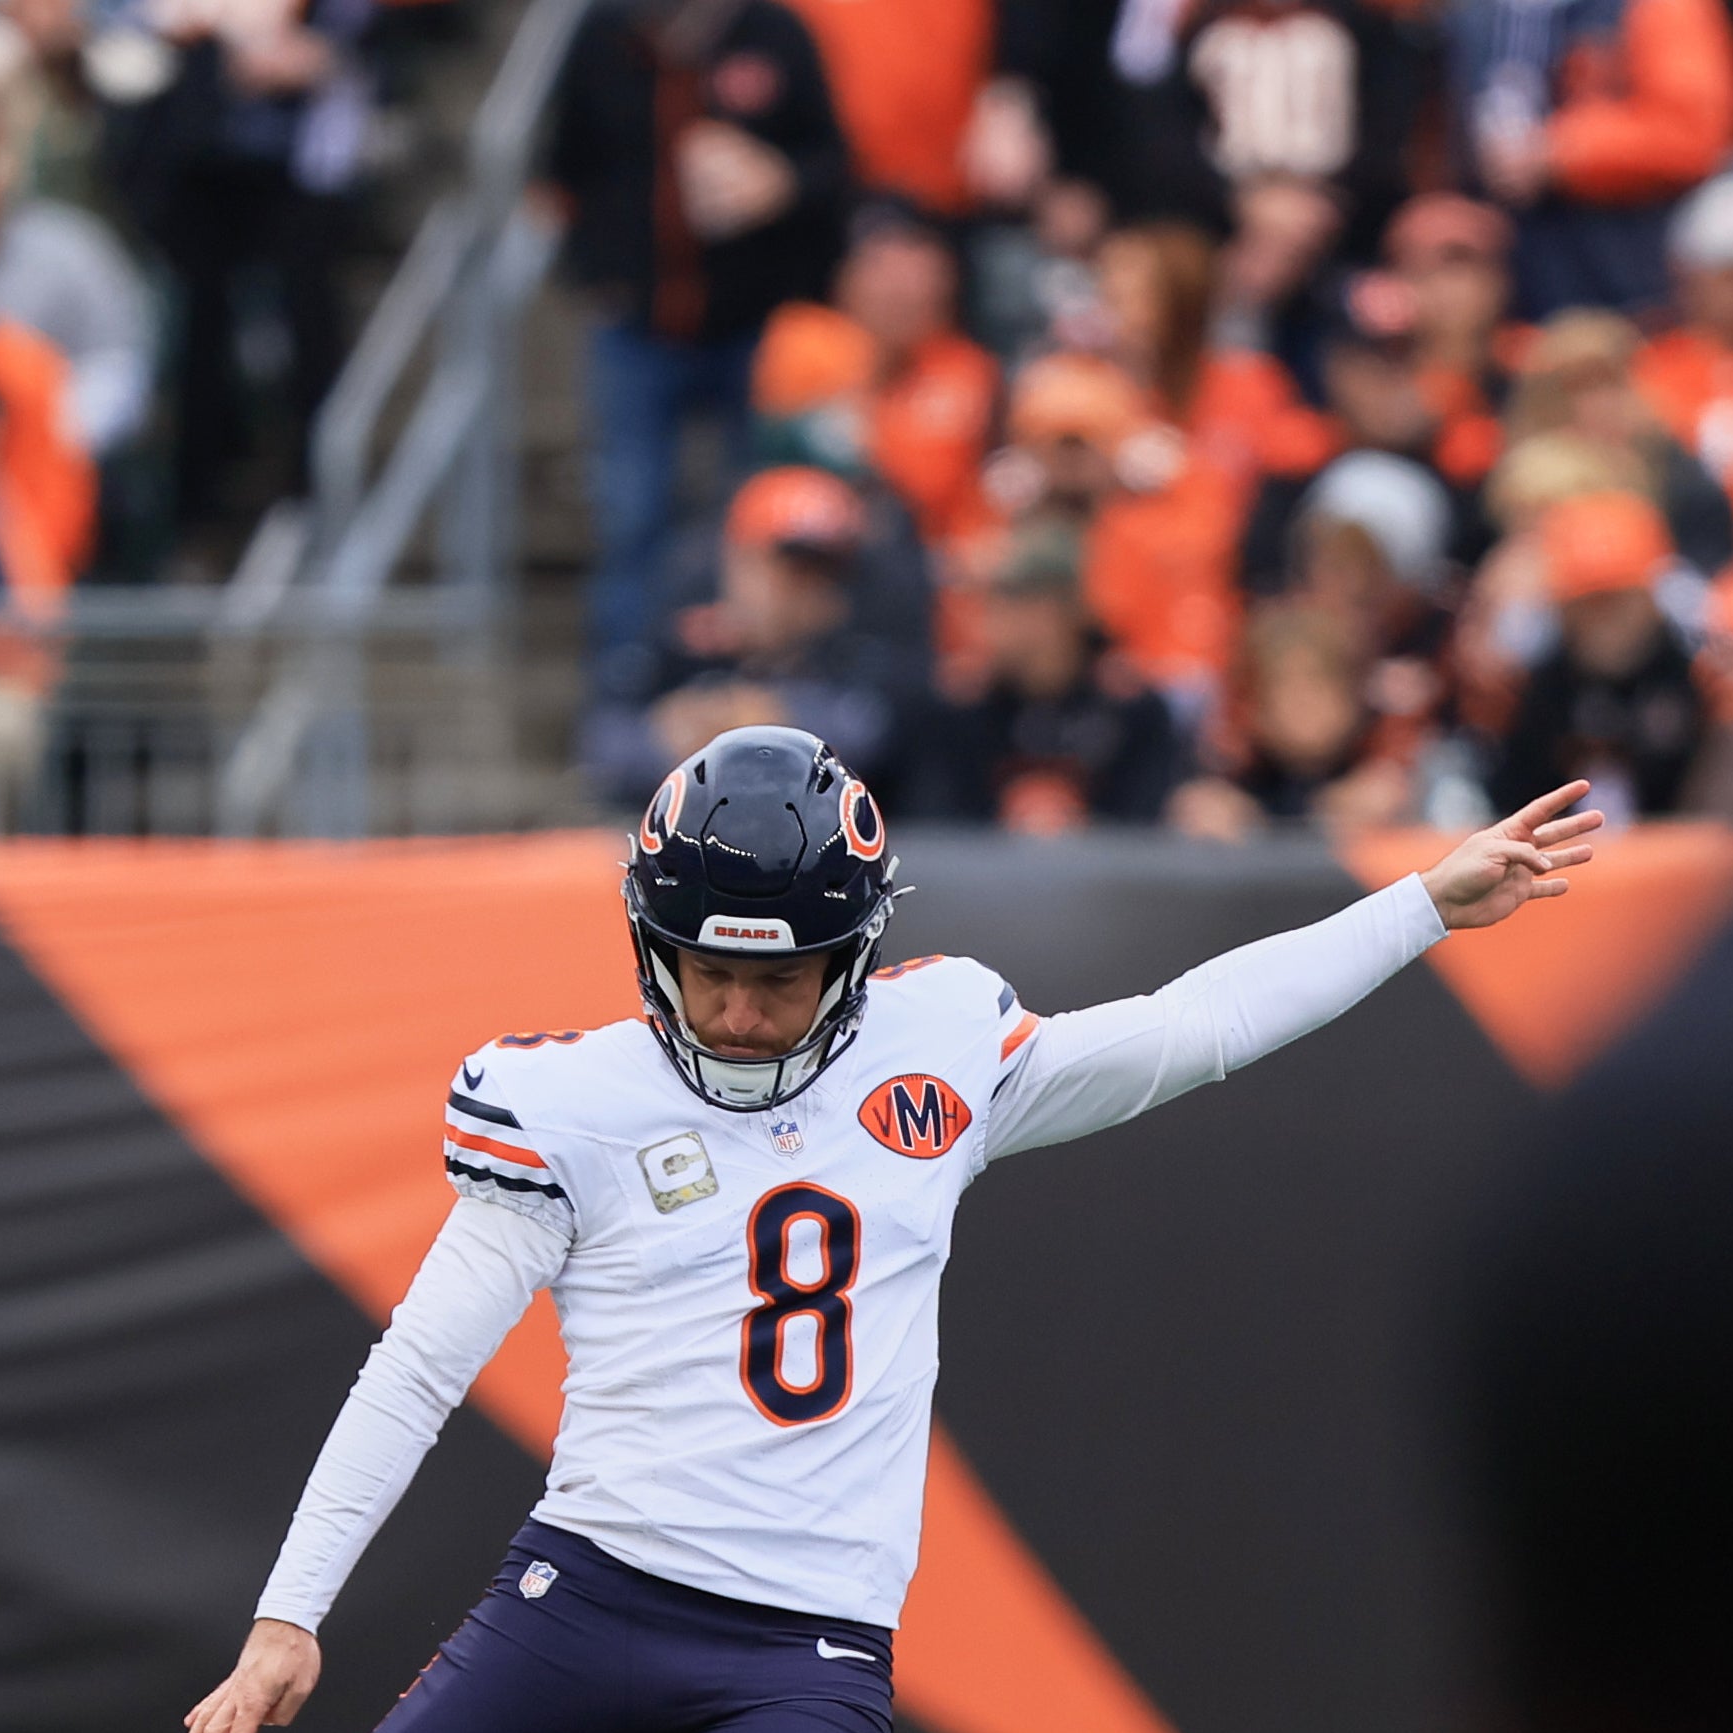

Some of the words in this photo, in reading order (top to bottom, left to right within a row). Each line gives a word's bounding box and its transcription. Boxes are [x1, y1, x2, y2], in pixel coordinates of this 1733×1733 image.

[714, 926, 779, 940] BEARS
[775, 1134, 802, 1151] NFL
[643, 1136, 707, 1193] C
[740, 1181, 861, 1427] 8
